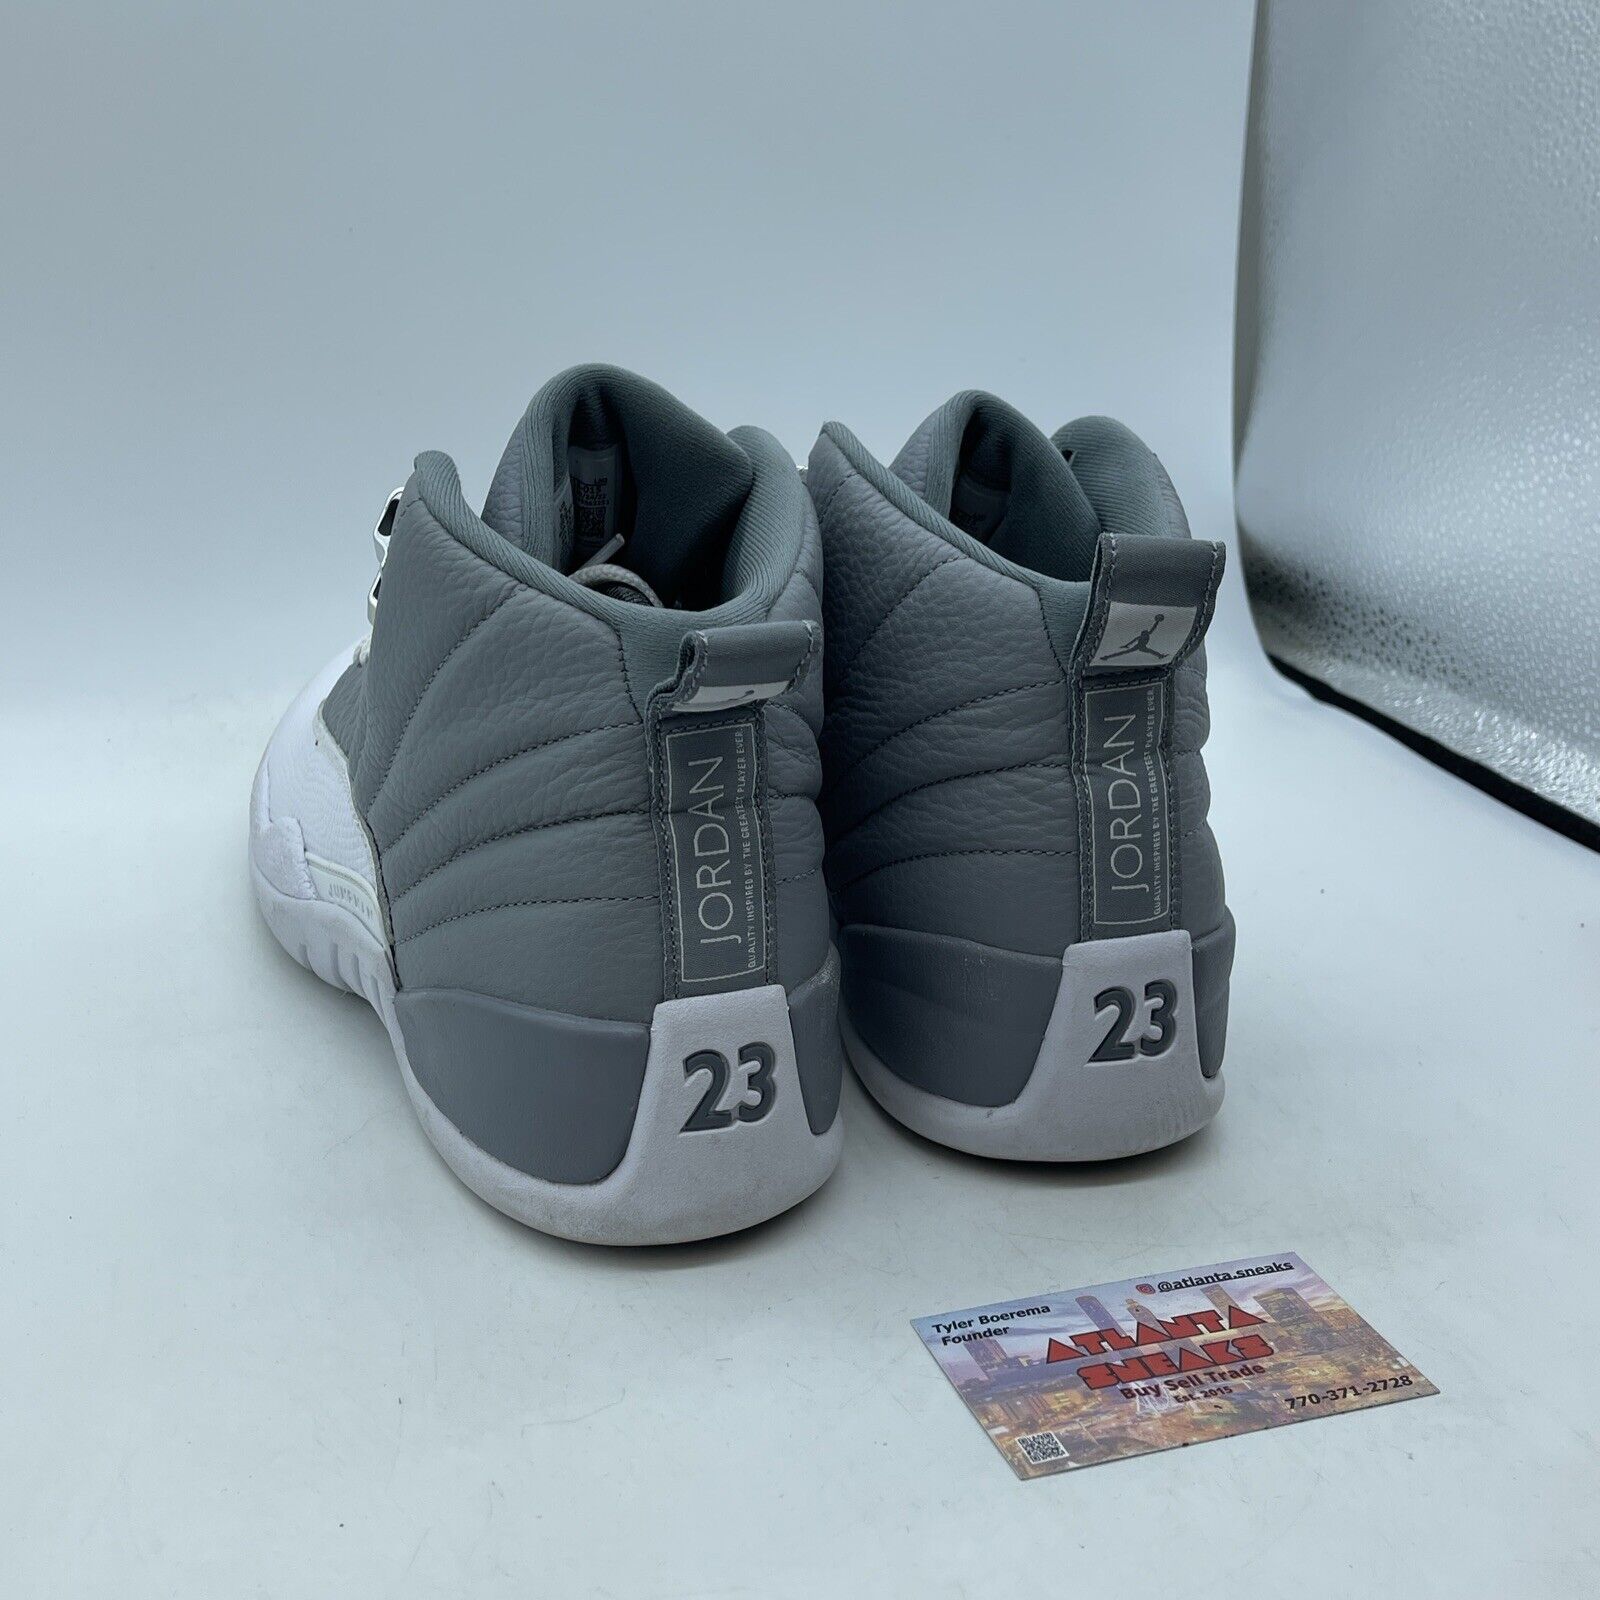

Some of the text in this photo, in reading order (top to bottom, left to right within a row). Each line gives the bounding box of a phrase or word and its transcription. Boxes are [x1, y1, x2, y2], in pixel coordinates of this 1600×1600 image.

[1145, 714, 1155, 748] PLAYER
[736, 756, 746, 793] PLAYER
[1144, 751, 1158, 794] GREATEST
[1102, 714, 1149, 893] JORDAN
[688, 756, 741, 944] JORDAN
[742, 840, 751, 859] THE
[744, 879, 754, 922] INSPIRED
[1153, 875, 1161, 915] QUALITY
[747, 926, 756, 968] QUALITY
[1087, 979, 1178, 1062] 23
[680, 1040, 777, 1133] 23
[1157, 1260, 1294, 1293] @atlanta.sneaks
[932, 1305, 1051, 1334] Tyler Boerema
[941, 1325, 1010, 1346] Founder
[1046, 1304, 1268, 1364] ATLANTA
[1076, 1333, 1274, 1390] SNEAKS
[1120, 1363, 1266, 1399] Buy Sell Trade
[1173, 1386, 1233, 1404] Est. 2015
[1284, 1374, 1413, 1409] 770-371-2728
